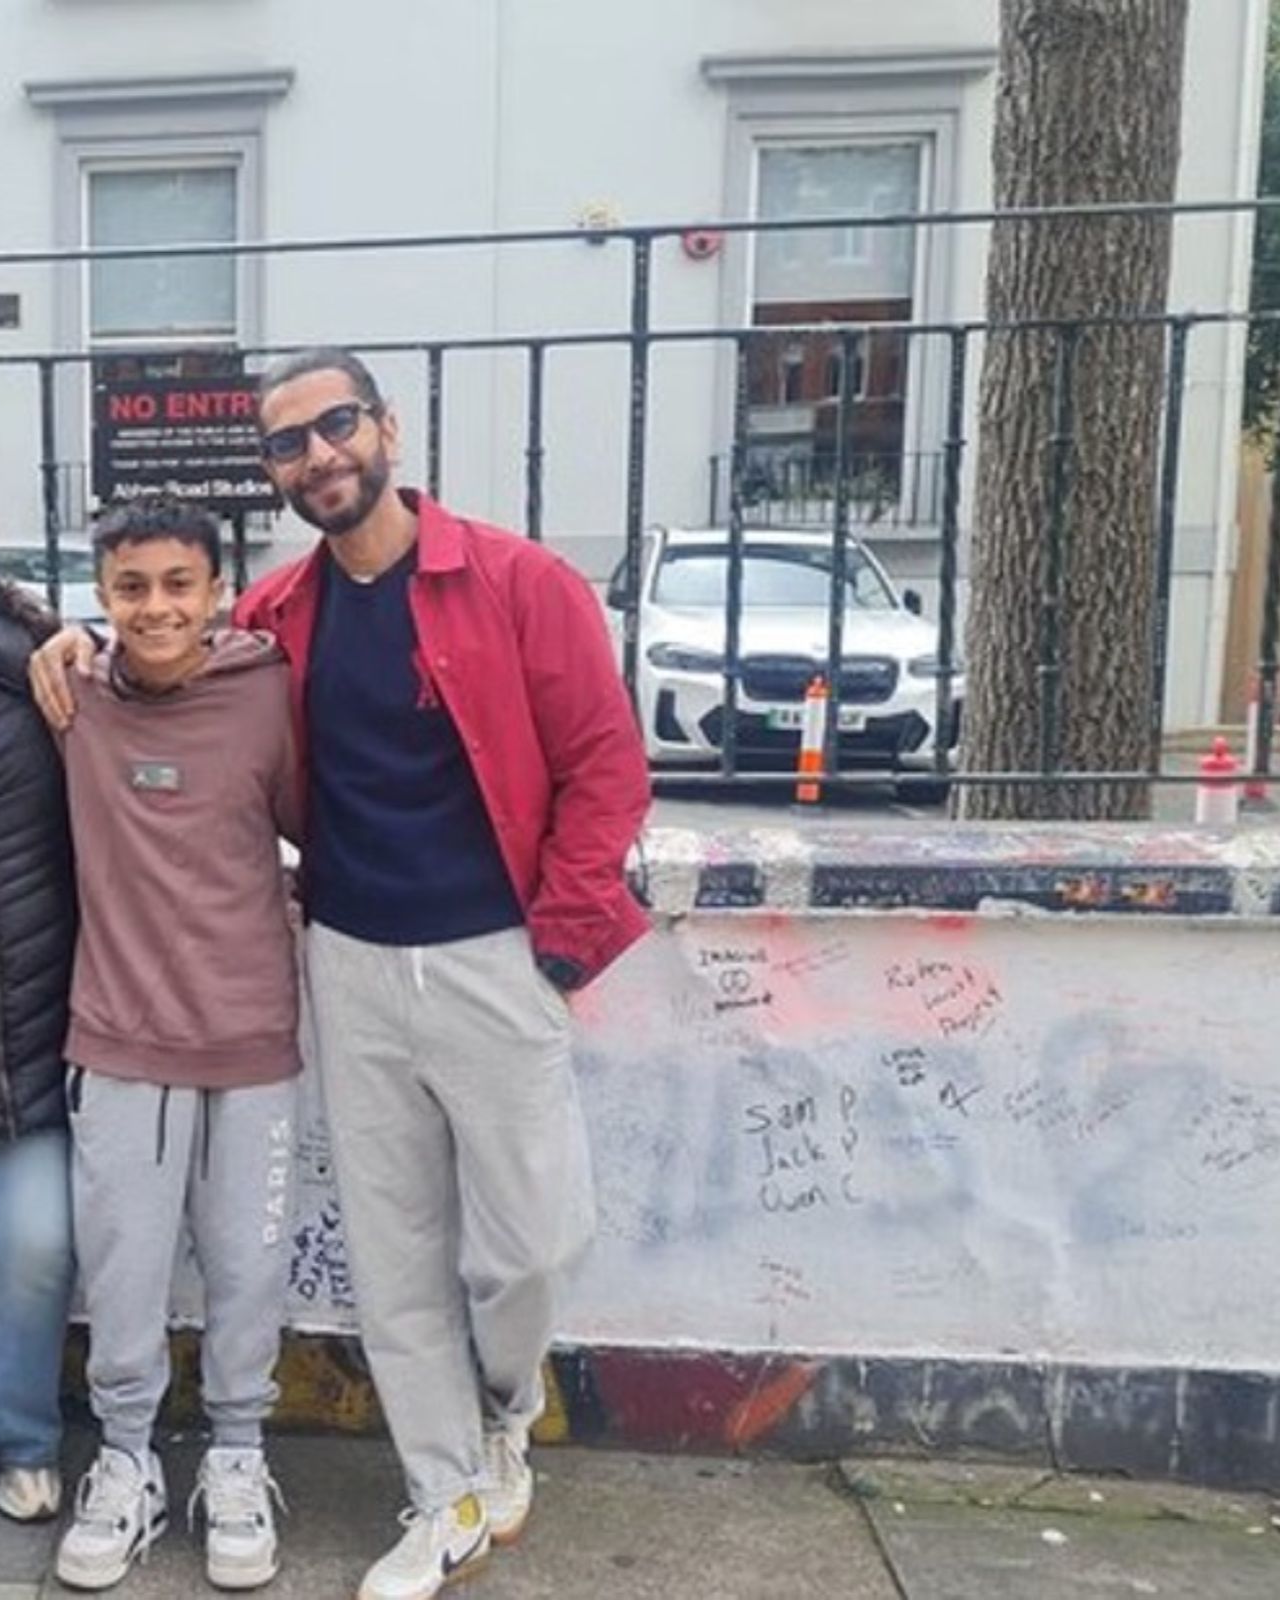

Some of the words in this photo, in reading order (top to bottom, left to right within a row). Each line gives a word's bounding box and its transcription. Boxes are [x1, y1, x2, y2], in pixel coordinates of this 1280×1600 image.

[110, 394, 156, 420] NO
[840, 1084, 857, 1122] P
[760, 1131, 826, 1177] Jack
[262, 1118, 291, 1246] PARIS
